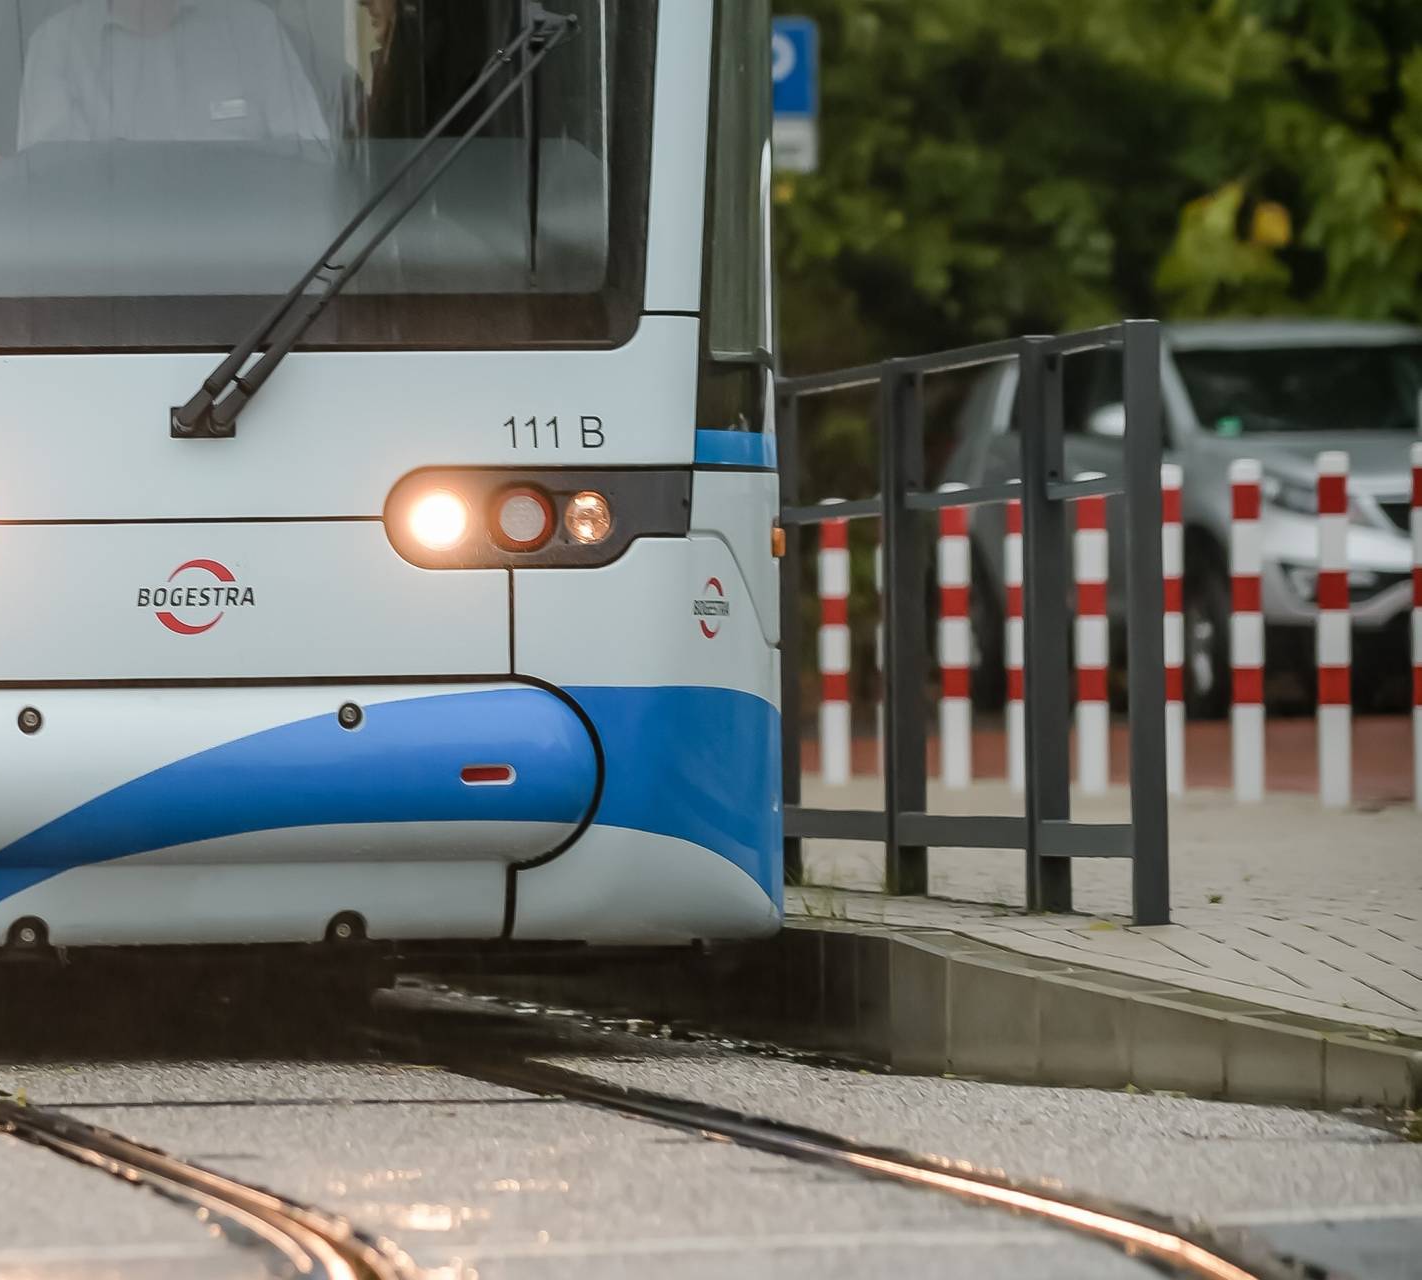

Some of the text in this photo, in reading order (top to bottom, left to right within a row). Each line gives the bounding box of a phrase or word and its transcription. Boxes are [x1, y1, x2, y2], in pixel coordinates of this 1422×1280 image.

[503, 415, 605, 449] 111 B
[137, 586, 255, 607] BOGESTRA
